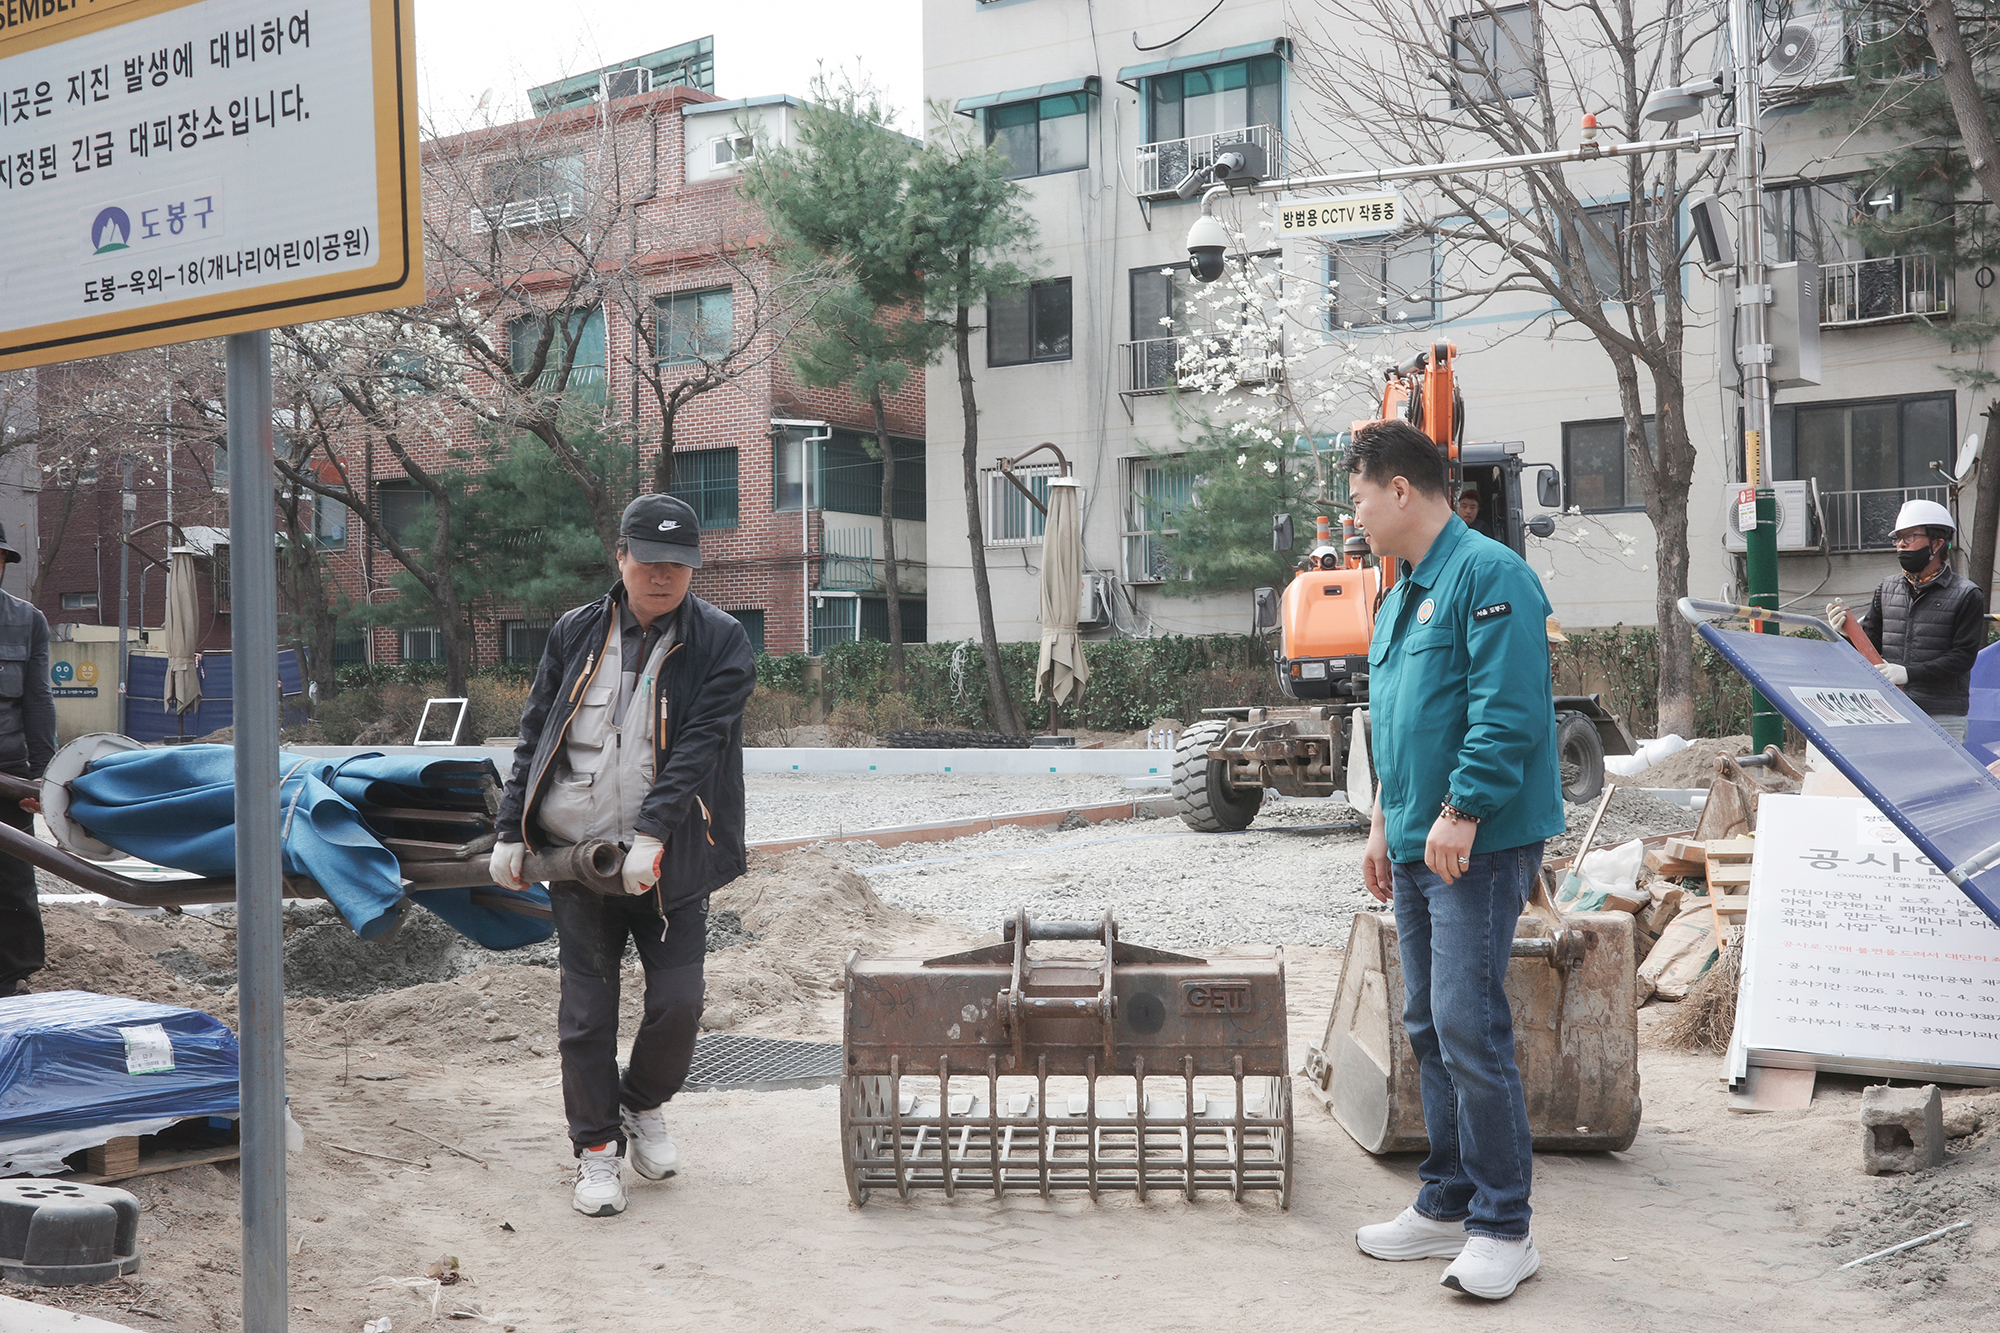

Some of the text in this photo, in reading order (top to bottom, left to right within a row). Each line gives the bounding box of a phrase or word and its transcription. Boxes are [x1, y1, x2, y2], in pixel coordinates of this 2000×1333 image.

[67, 64, 109, 106] 지진
[124, 41, 194, 94] 발생에
[210, 9, 310, 69] 대비하여
[72, 131, 114, 173] 긴급
[130, 83, 310, 158] 대피장소입니다.
[141, 195, 215, 240] 도봉구
[1283, 202, 1395, 229] 방범용 CCTV 작동중
[83, 226, 370, 303] 도봉-옥외-18(개나리어린이공원)
[1837, 872, 1911, 883] construction
[1780, 888, 1862, 900] 어린이공원
[1875, 894, 1892, 902] 내
[1902, 896, 1934, 905] 노후
[1780, 897, 1812, 907] 하여
[1822, 899, 1886, 911] 안전하고
[1780, 907, 1830, 919] 공간을
[1844, 911, 1894, 921] 만드는
[1780, 917, 1828, 929] 재정비
[1885, 924, 1943, 937] 입니다.
[1782, 940, 1822, 950] 공사로
[1825, 944, 1852, 953] 인해
[1858, 946, 1898, 957] 불편을
[1945, 953, 1987, 963] 대단히
[1786, 978, 1842, 991] 공사기간
[1853, 985, 1888, 995] 2026.
[1854, 969, 1895, 979] 개나리
[1902, 973, 1973, 986] 어린이공원
[1785, 1015, 1842, 1028] 공사부서
[1854, 1021, 1912, 1033] 도봉구청
